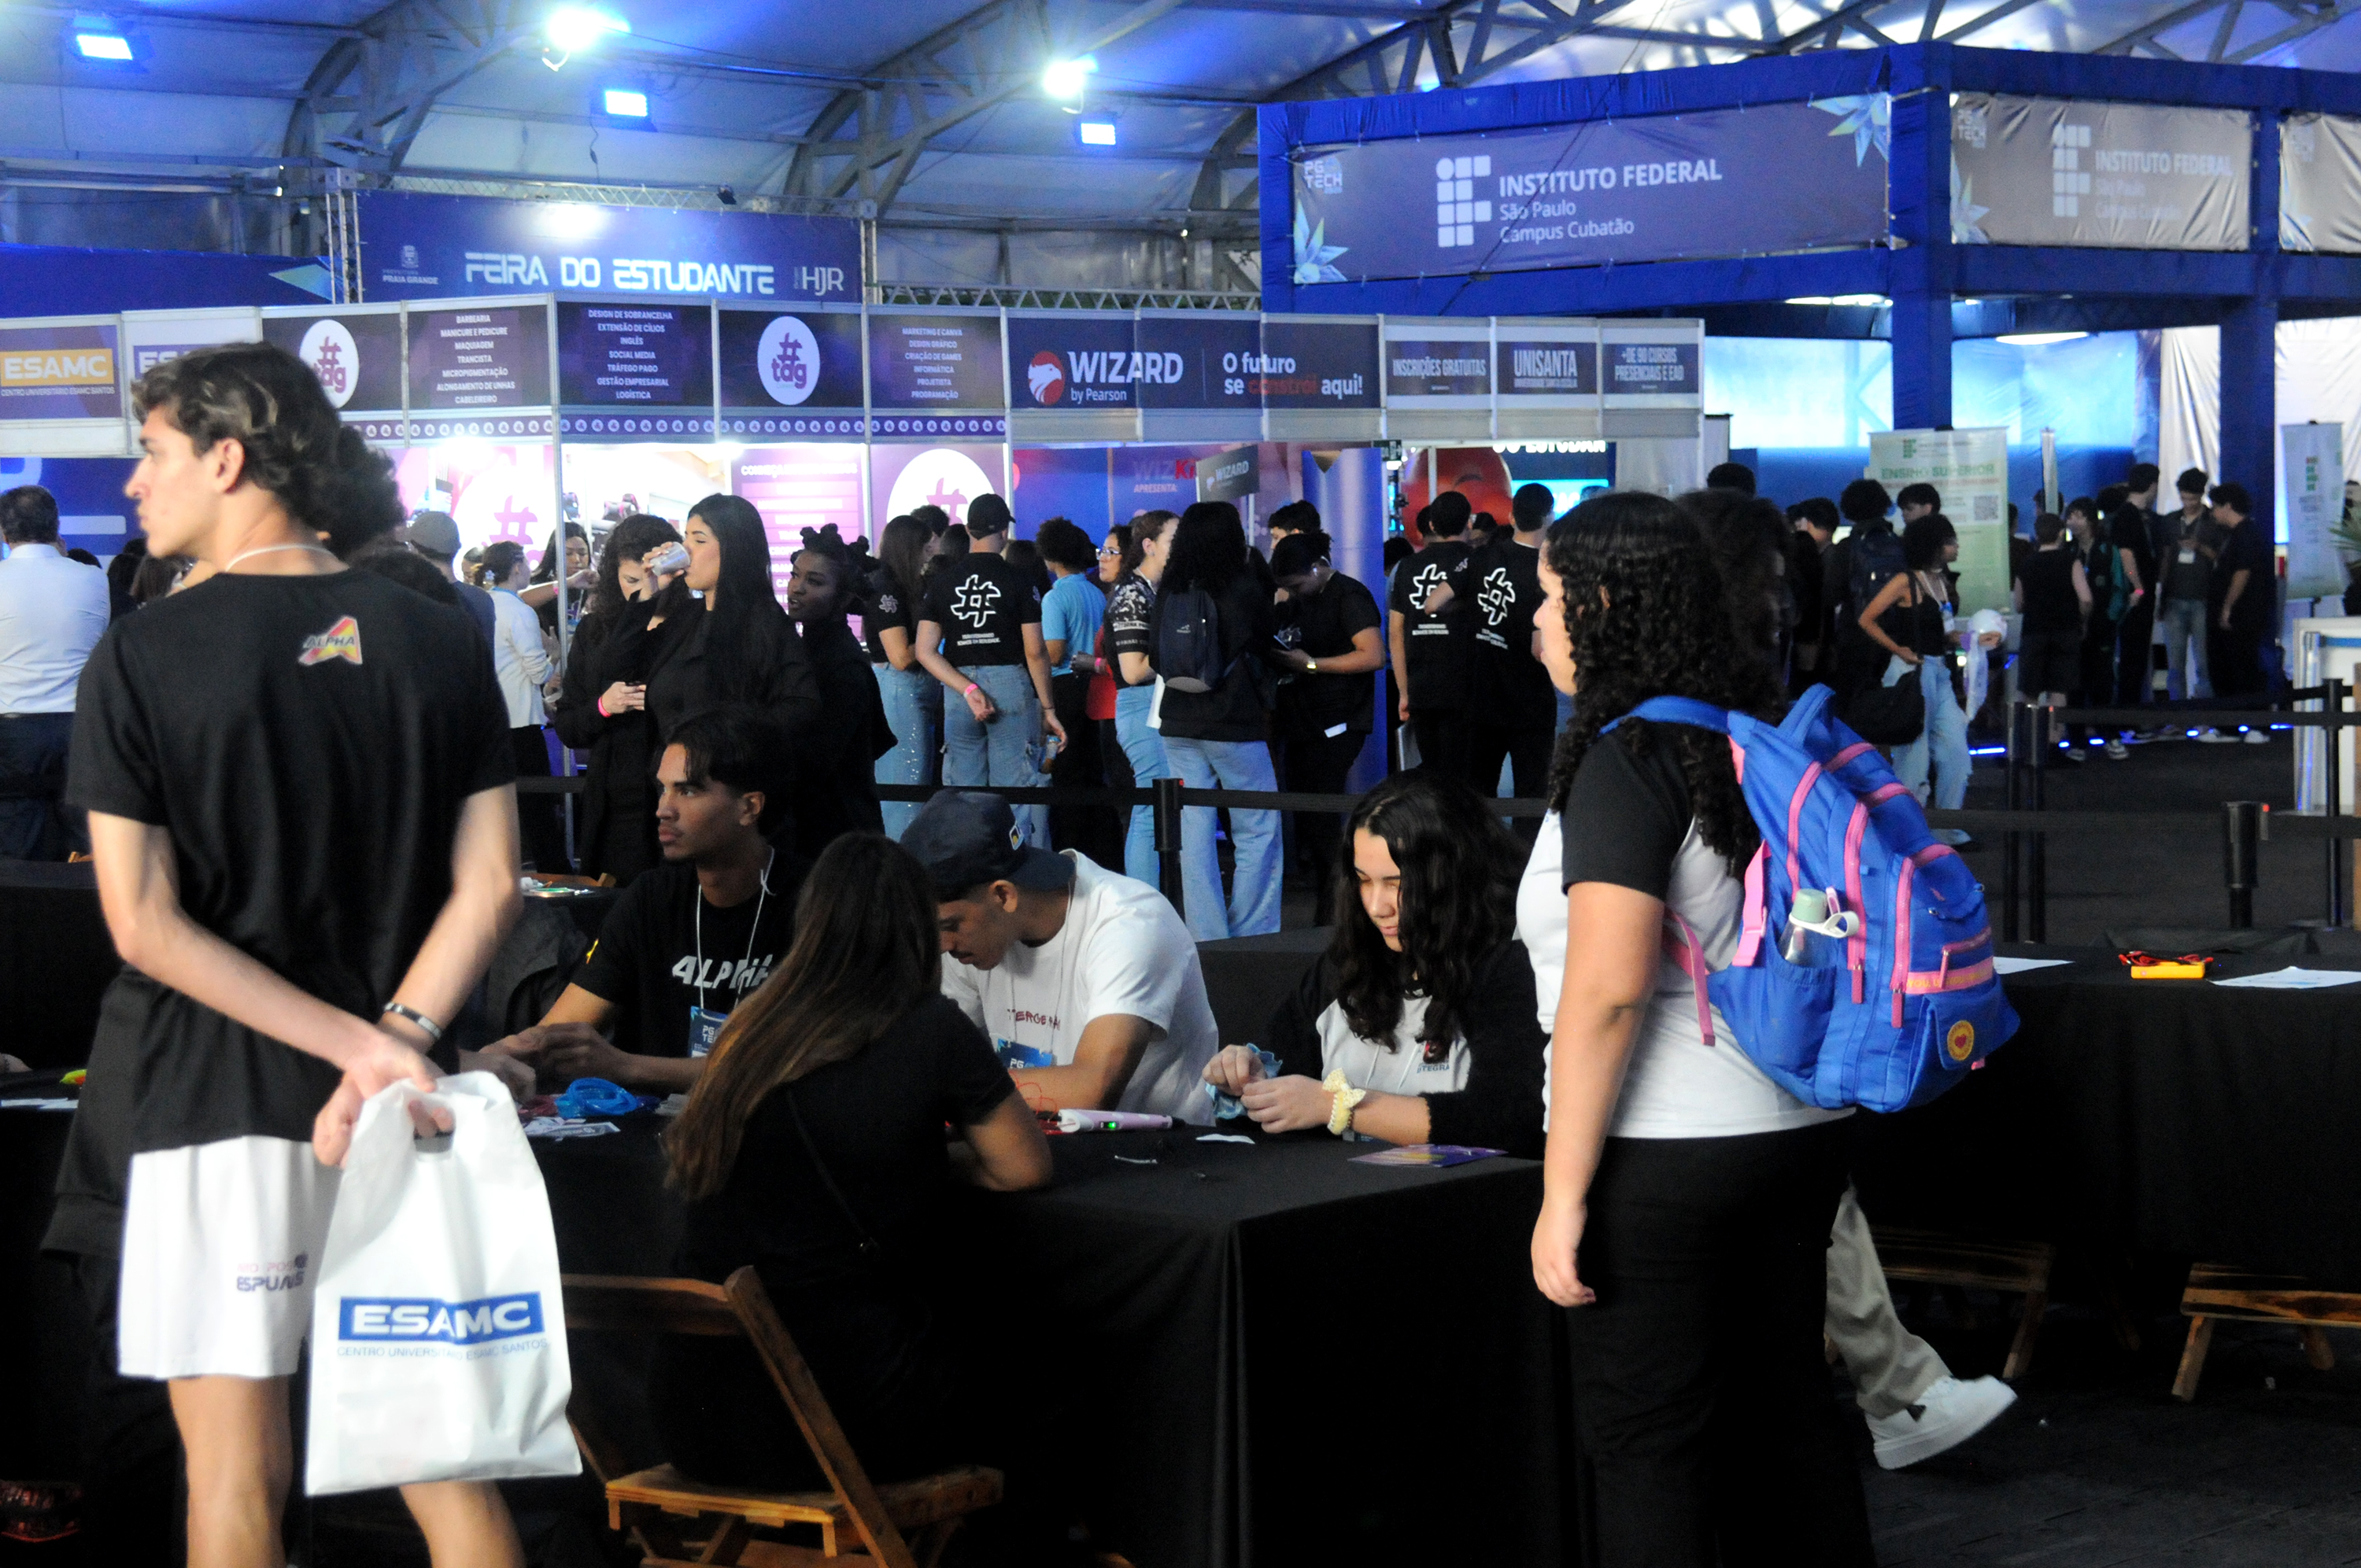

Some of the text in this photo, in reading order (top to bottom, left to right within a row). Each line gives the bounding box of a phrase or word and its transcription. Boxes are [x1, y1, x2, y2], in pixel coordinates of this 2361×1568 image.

[1304, 160, 1324, 174] PG
[1304, 174, 1343, 188] TECH
[1499, 159, 1722, 197] INSTITUTO FEDERAL
[1500, 200, 1576, 221] São Paulo
[1502, 218, 1635, 245] Campus Cubatão
[465, 252, 549, 286] FEIRA
[560, 256, 600, 288] DO
[613, 259, 774, 294] ESTUDANTE
[456, 314, 491, 323] BARBEARIA
[588, 309, 614, 319] DESIGN
[615, 310, 623, 319] DE
[440, 328, 474, 338] MANICURE
[478, 327, 508, 336] PEDICURE
[597, 322, 633, 332] EXTENSÃO
[634, 323, 643, 332] DE
[454, 341, 494, 351] MAQUIAGEM
[4, 356, 108, 380] ESAMC
[457, 355, 493, 363] TRANCISTA
[1067, 351, 1184, 384] WIZARD
[1223, 352, 1297, 374] O futuro
[1392, 356, 1487, 379] INSCRIÇÕES GRATUITAS
[1514, 350, 1578, 377] UNISANTA
[493, 380, 515, 390] UNHAS
[1070, 386, 1127, 404] by Pearson
[1225, 378, 1245, 395] se
[1321, 374, 1363, 400] aqui!
[304, 636, 356, 648] ALPHA
[352, 1301, 530, 1338] ESAMC
[337, 1346, 385, 1356] CENTRO
[467, 1346, 499, 1360] ESAMC
[502, 1338, 547, 1355] SANTOS
